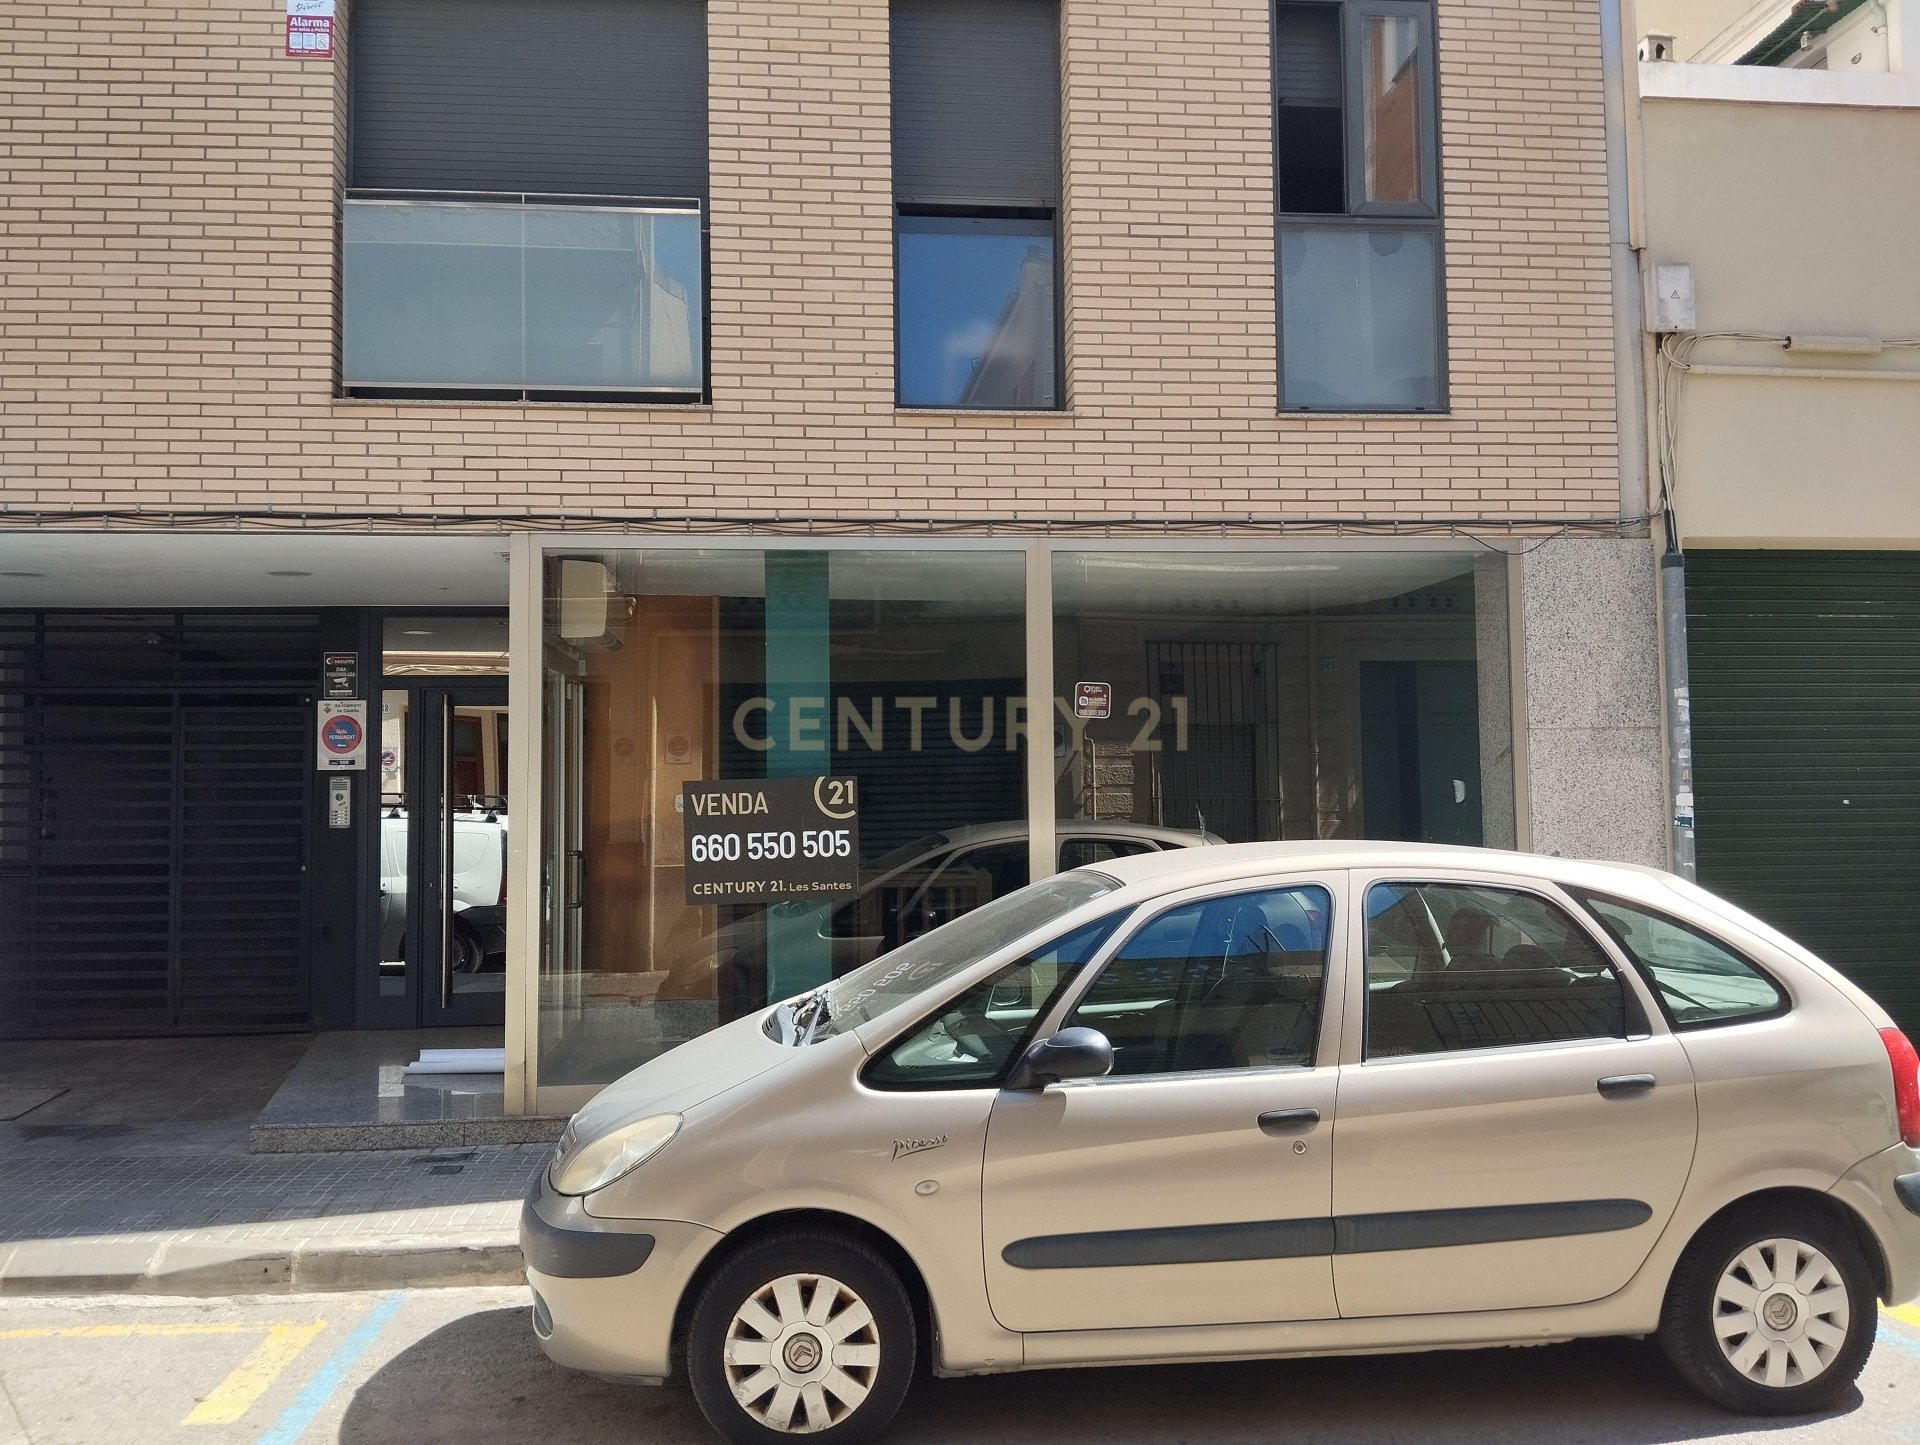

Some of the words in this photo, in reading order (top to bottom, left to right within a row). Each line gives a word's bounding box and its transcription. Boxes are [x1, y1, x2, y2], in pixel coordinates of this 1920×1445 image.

[290, 17, 330, 27] Alarma
[690, 791, 769, 816] VENDA
[691, 833, 741, 862] 660
[747, 831, 796, 860] 550
[802, 829, 851, 858] 505
[692, 880, 766, 895] CENTURY
[789, 882, 809, 892] Les
[811, 880, 852, 892] Santes
